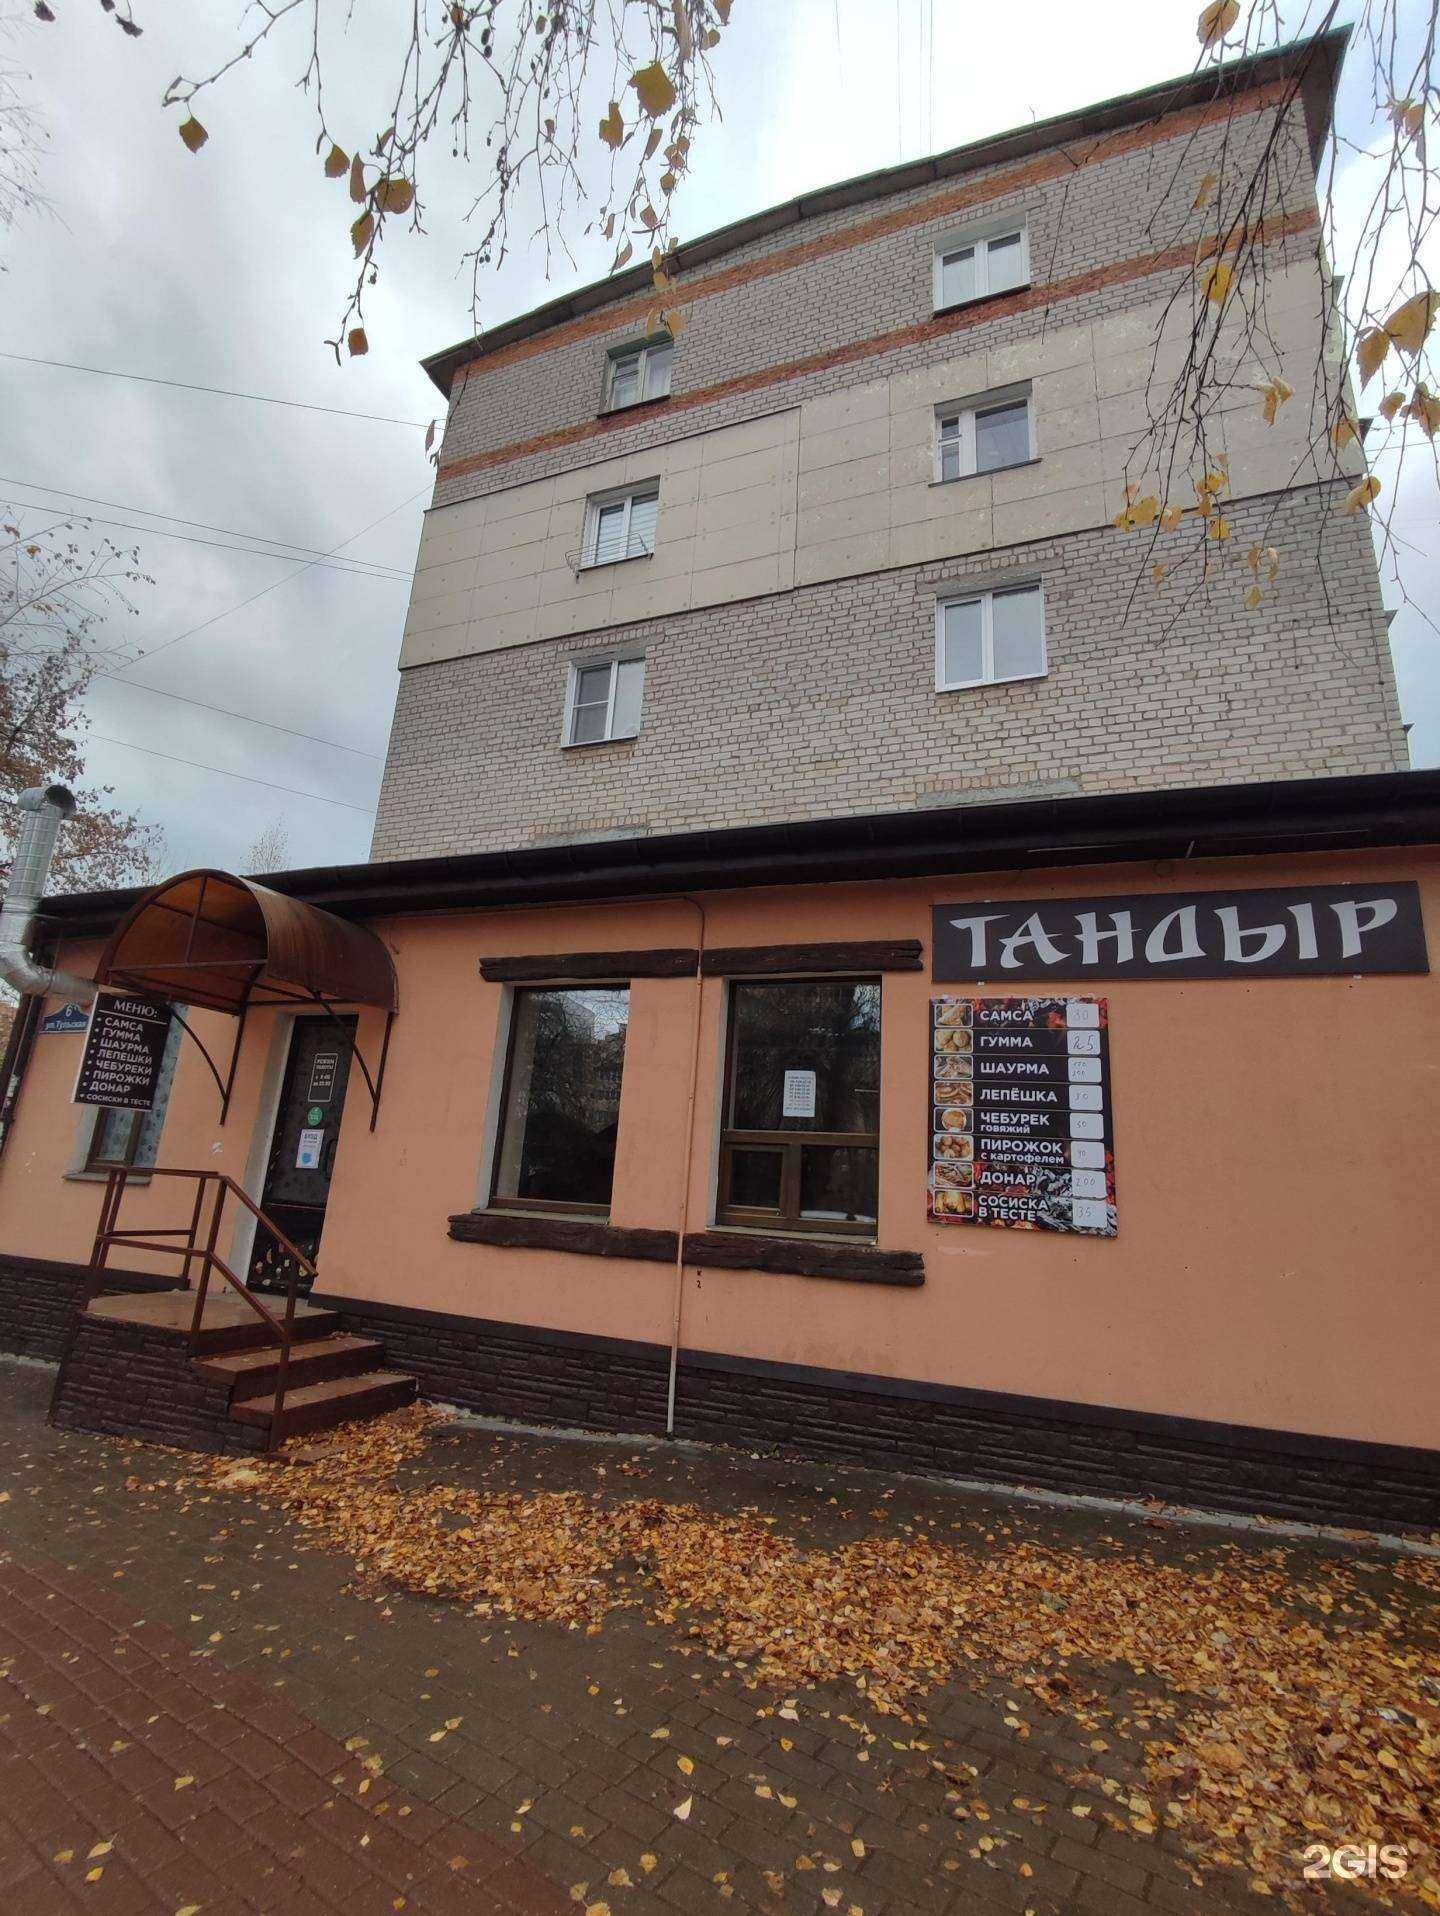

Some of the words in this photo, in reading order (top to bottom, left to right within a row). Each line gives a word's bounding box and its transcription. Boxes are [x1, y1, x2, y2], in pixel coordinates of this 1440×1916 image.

[948, 899, 1399, 969] ТАНДЫР
[113, 1000, 158, 1018] МЕНЮ:
[980, 1010, 1034, 1021] САМСА
[104, 1017, 143, 1032] САМСА
[102, 1028, 140, 1041] ГУММА
[980, 1036, 1033, 1048] ГУММА
[100, 1038, 149, 1054] ШАУРМА
[1073, 1034, 1095, 1051] 25
[97, 1049, 152, 1065] ЛЕПЕШКИ
[96, 1060, 152, 1075] ЧЕБУРЕКИ
[980, 1062, 1050, 1075] ШАУРМА
[93, 1070, 150, 1086] ПИРОЖКИ
[89, 1081, 131, 1093] ДОНАР
[980, 1087, 1058, 1102] ЛЕПЁШКА
[86, 1093, 123, 1104] СОСИСКИ
[130, 1098, 151, 1106] ТЕСТЕ
[980, 1112, 1050, 1126] ЧЕБУРЕК
[980, 1124, 1030, 1134] говяжий
[980, 1138, 1063, 1154] ПИРОЖОК
[980, 1152, 987, 1160] с
[990, 1152, 1064, 1164] картофелем
[980, 1172, 1036, 1185] ДОНАР
[978, 1195, 1048, 1210] СОСИСКА
[978, 1206, 988, 1217] В
[991, 1207, 1036, 1221] ТЕСТЕ
